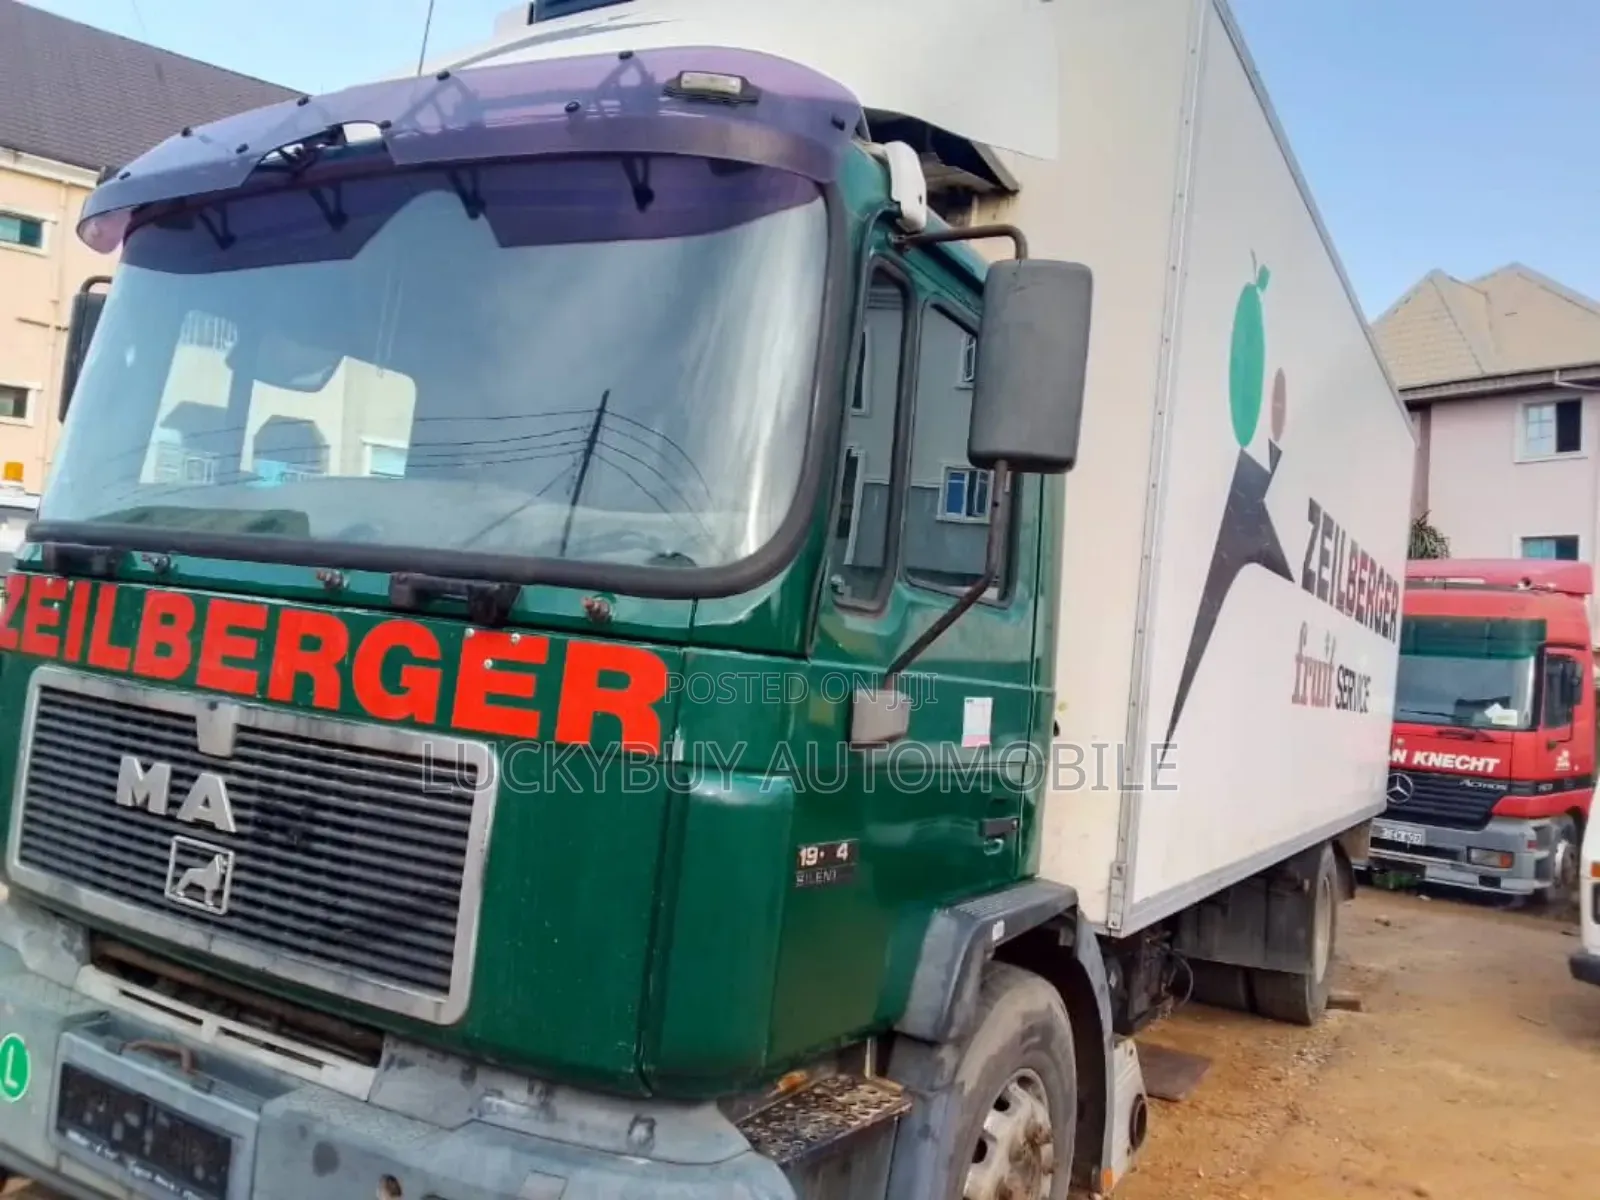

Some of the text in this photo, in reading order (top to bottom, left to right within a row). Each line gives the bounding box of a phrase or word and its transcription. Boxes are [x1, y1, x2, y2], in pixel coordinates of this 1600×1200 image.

[1302, 497, 1399, 644] ZEILBERGER
[0, 573, 668, 756] ZEILBERGER
[1292, 620, 1371, 713] fruit SERVICE
[1412, 751, 1500, 773] KNECHT
[4, 1045, 18, 1089] L
